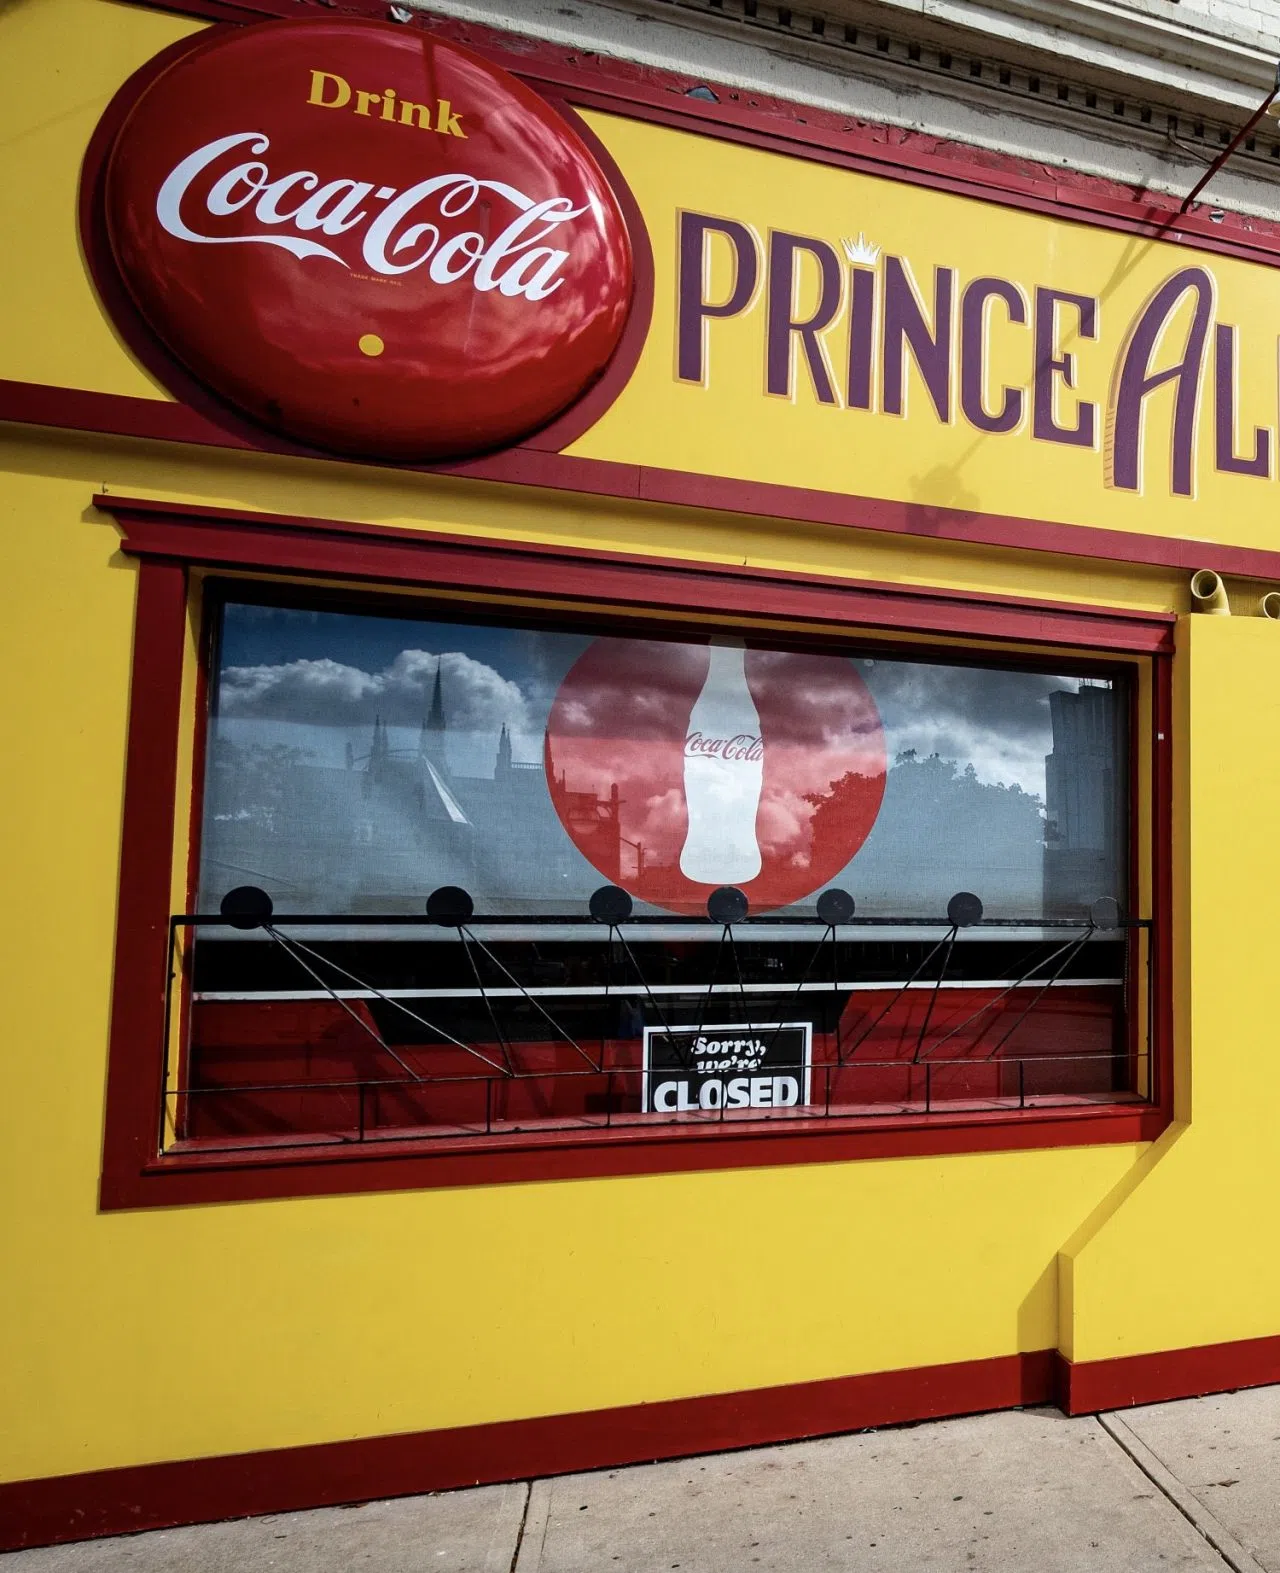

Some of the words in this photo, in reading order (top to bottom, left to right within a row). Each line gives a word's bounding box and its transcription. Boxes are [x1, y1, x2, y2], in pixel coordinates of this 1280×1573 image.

[306, 69, 469, 139] Drink
[156, 132, 594, 301] Coca-Cola
[674, 206, 1099, 451] PRINCE
[684, 731, 763, 761] Coca-Cola
[691, 1037, 766, 1057] Sorry,
[654, 1076, 798, 1112] CLOSED
